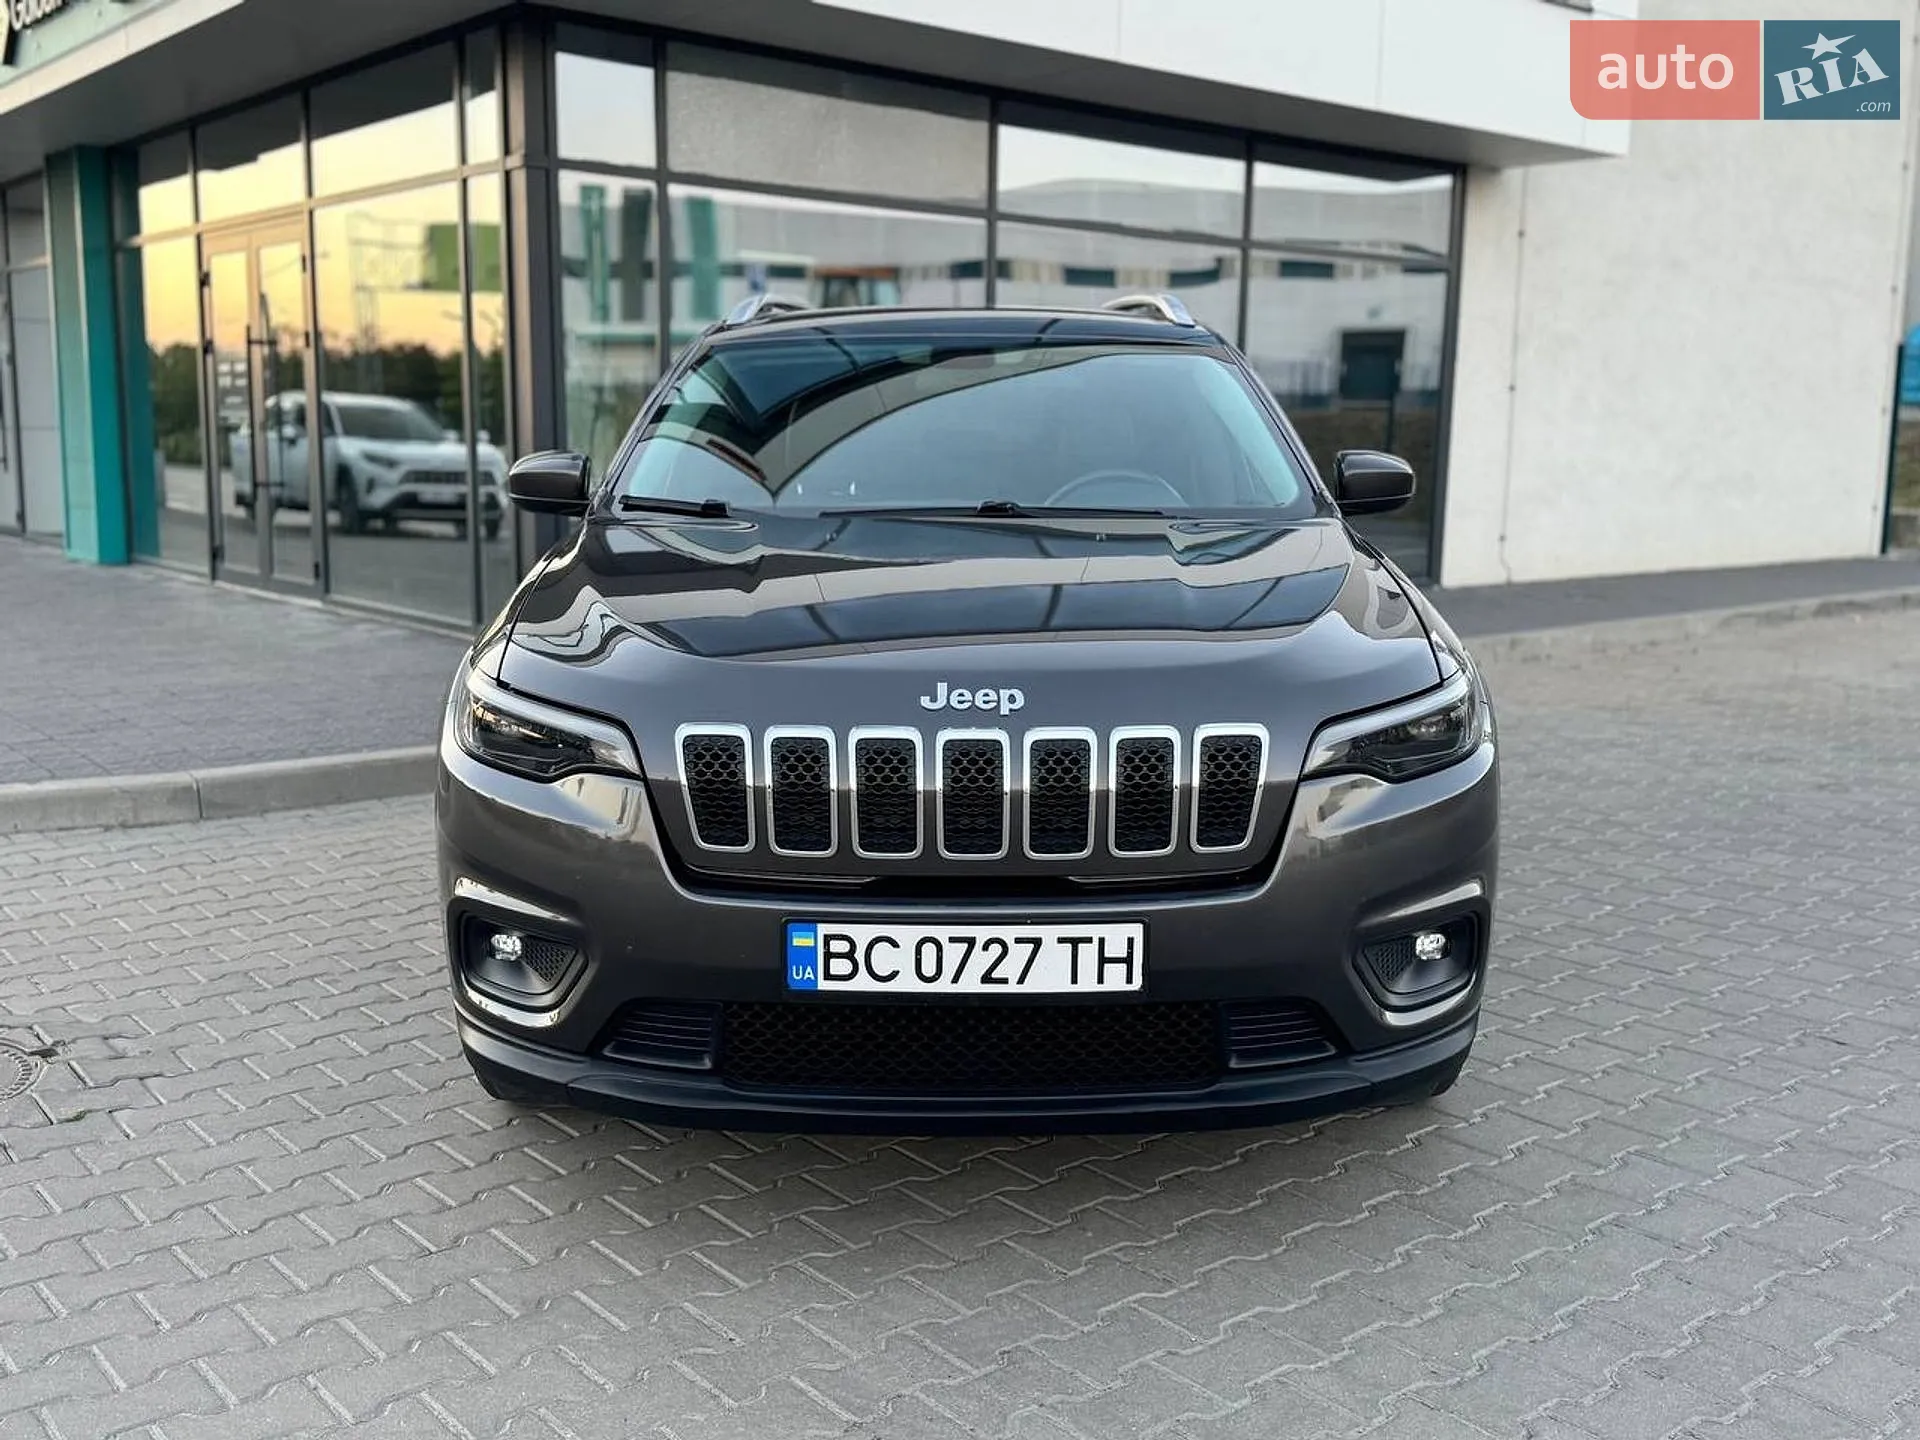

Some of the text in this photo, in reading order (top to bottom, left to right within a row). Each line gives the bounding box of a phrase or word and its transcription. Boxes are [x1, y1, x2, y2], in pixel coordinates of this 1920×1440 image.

[920, 682, 1025, 715] Jeep
[792, 965, 815, 980] UA
[823, 934, 1135, 985] BC 0727 TH
